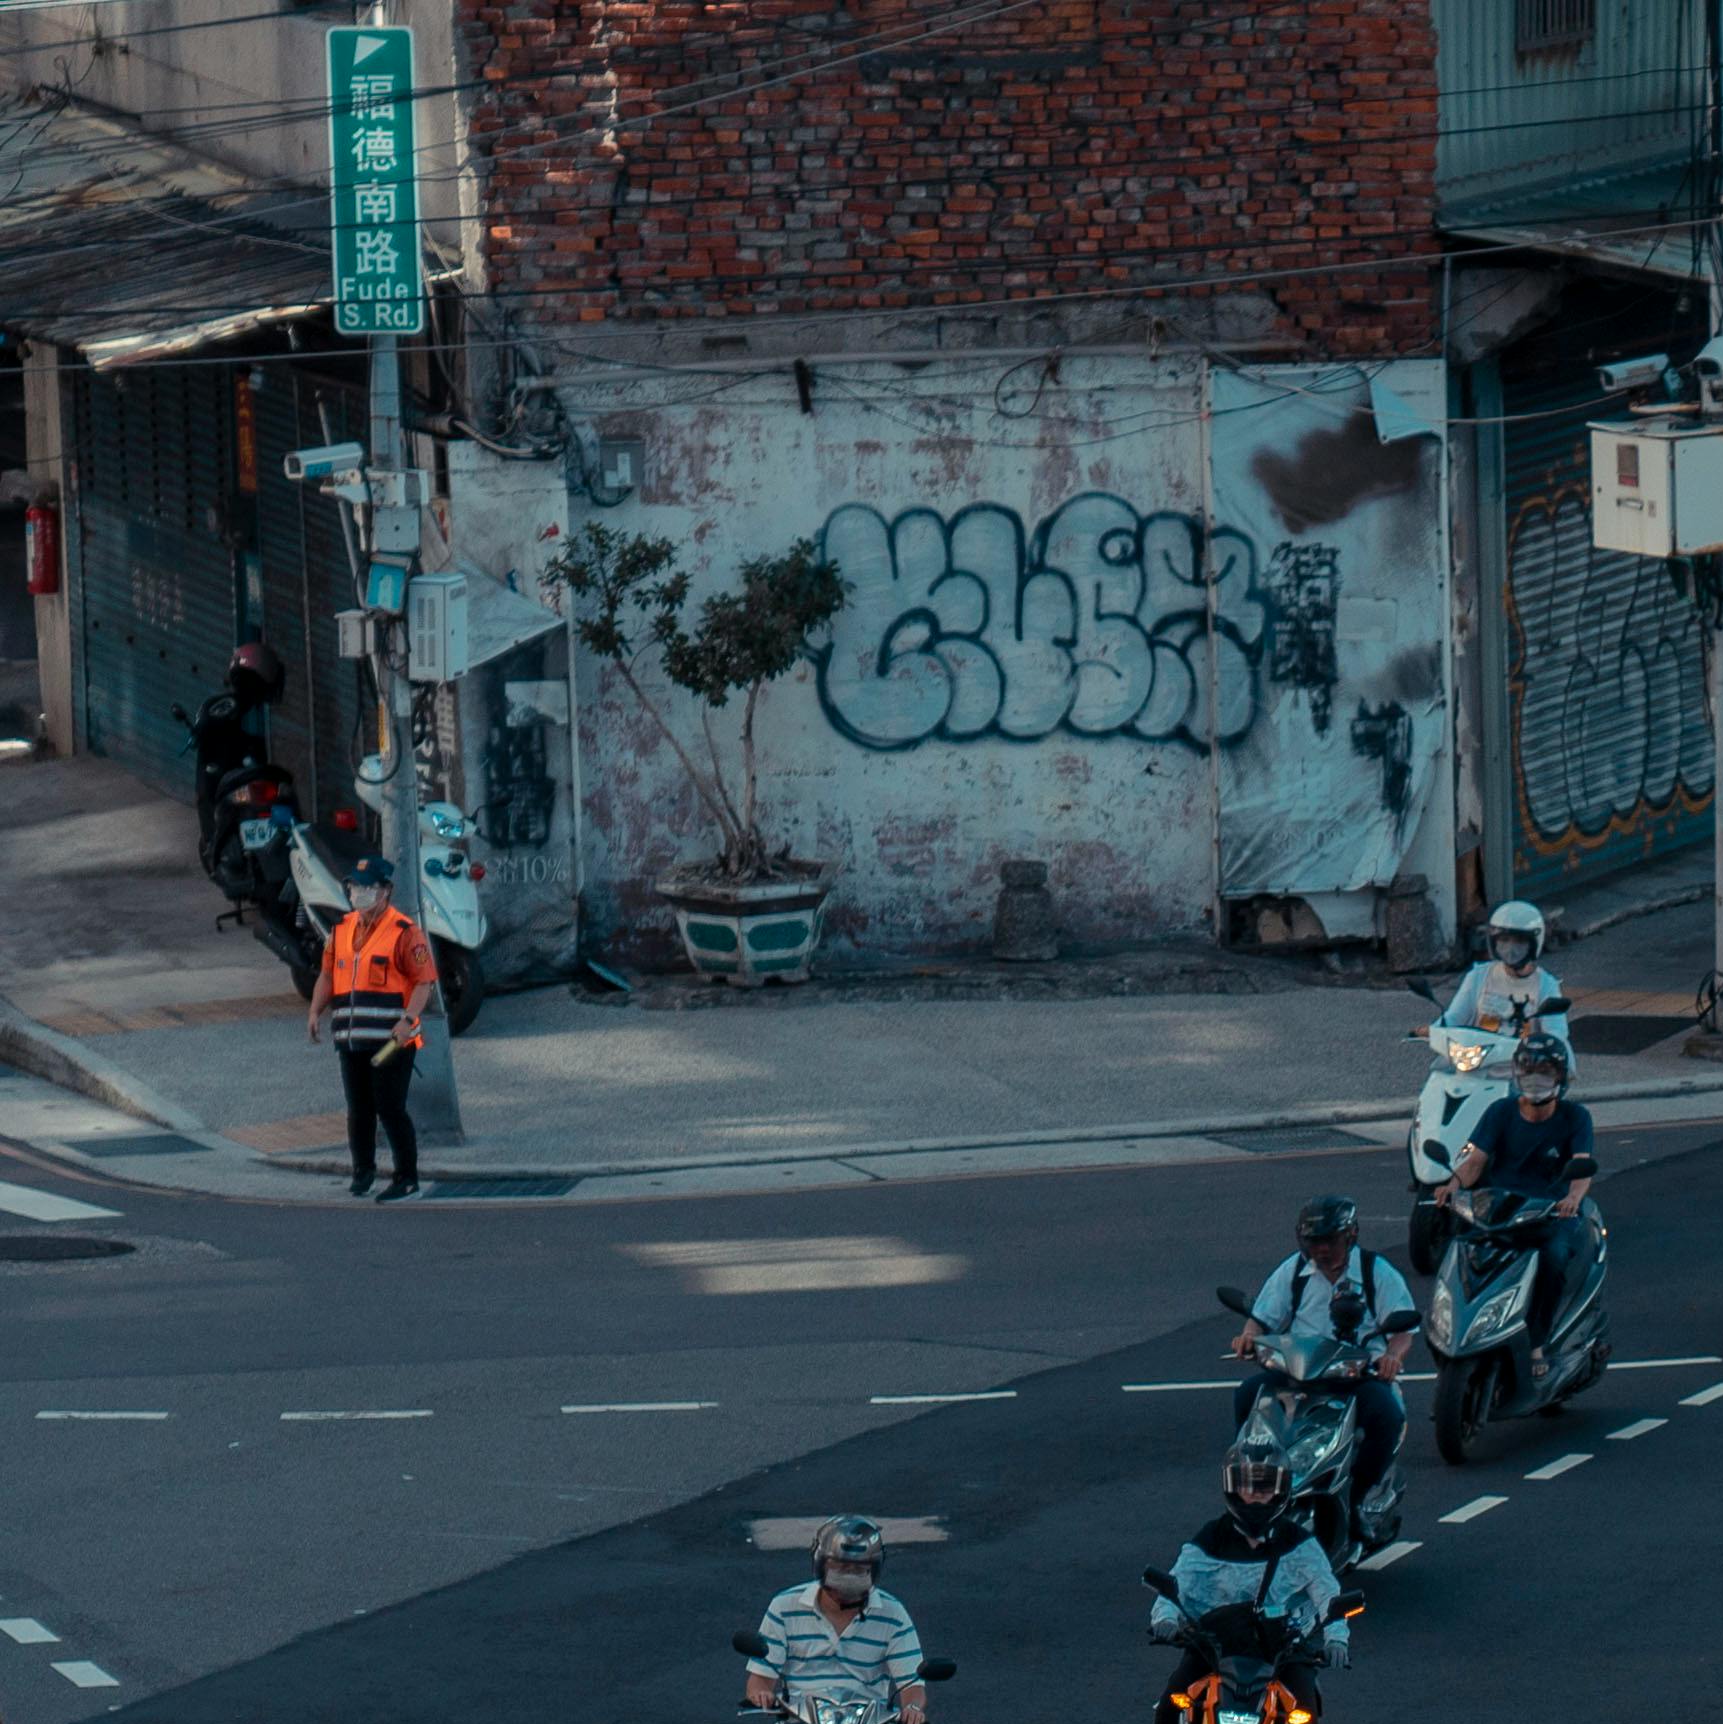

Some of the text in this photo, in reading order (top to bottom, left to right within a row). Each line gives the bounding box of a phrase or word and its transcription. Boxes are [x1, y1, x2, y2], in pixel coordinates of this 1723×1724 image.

[350, 74, 399, 275] 福德南路
[341, 277, 409, 300] Fude
[344, 302, 415, 327] S. Rd.
